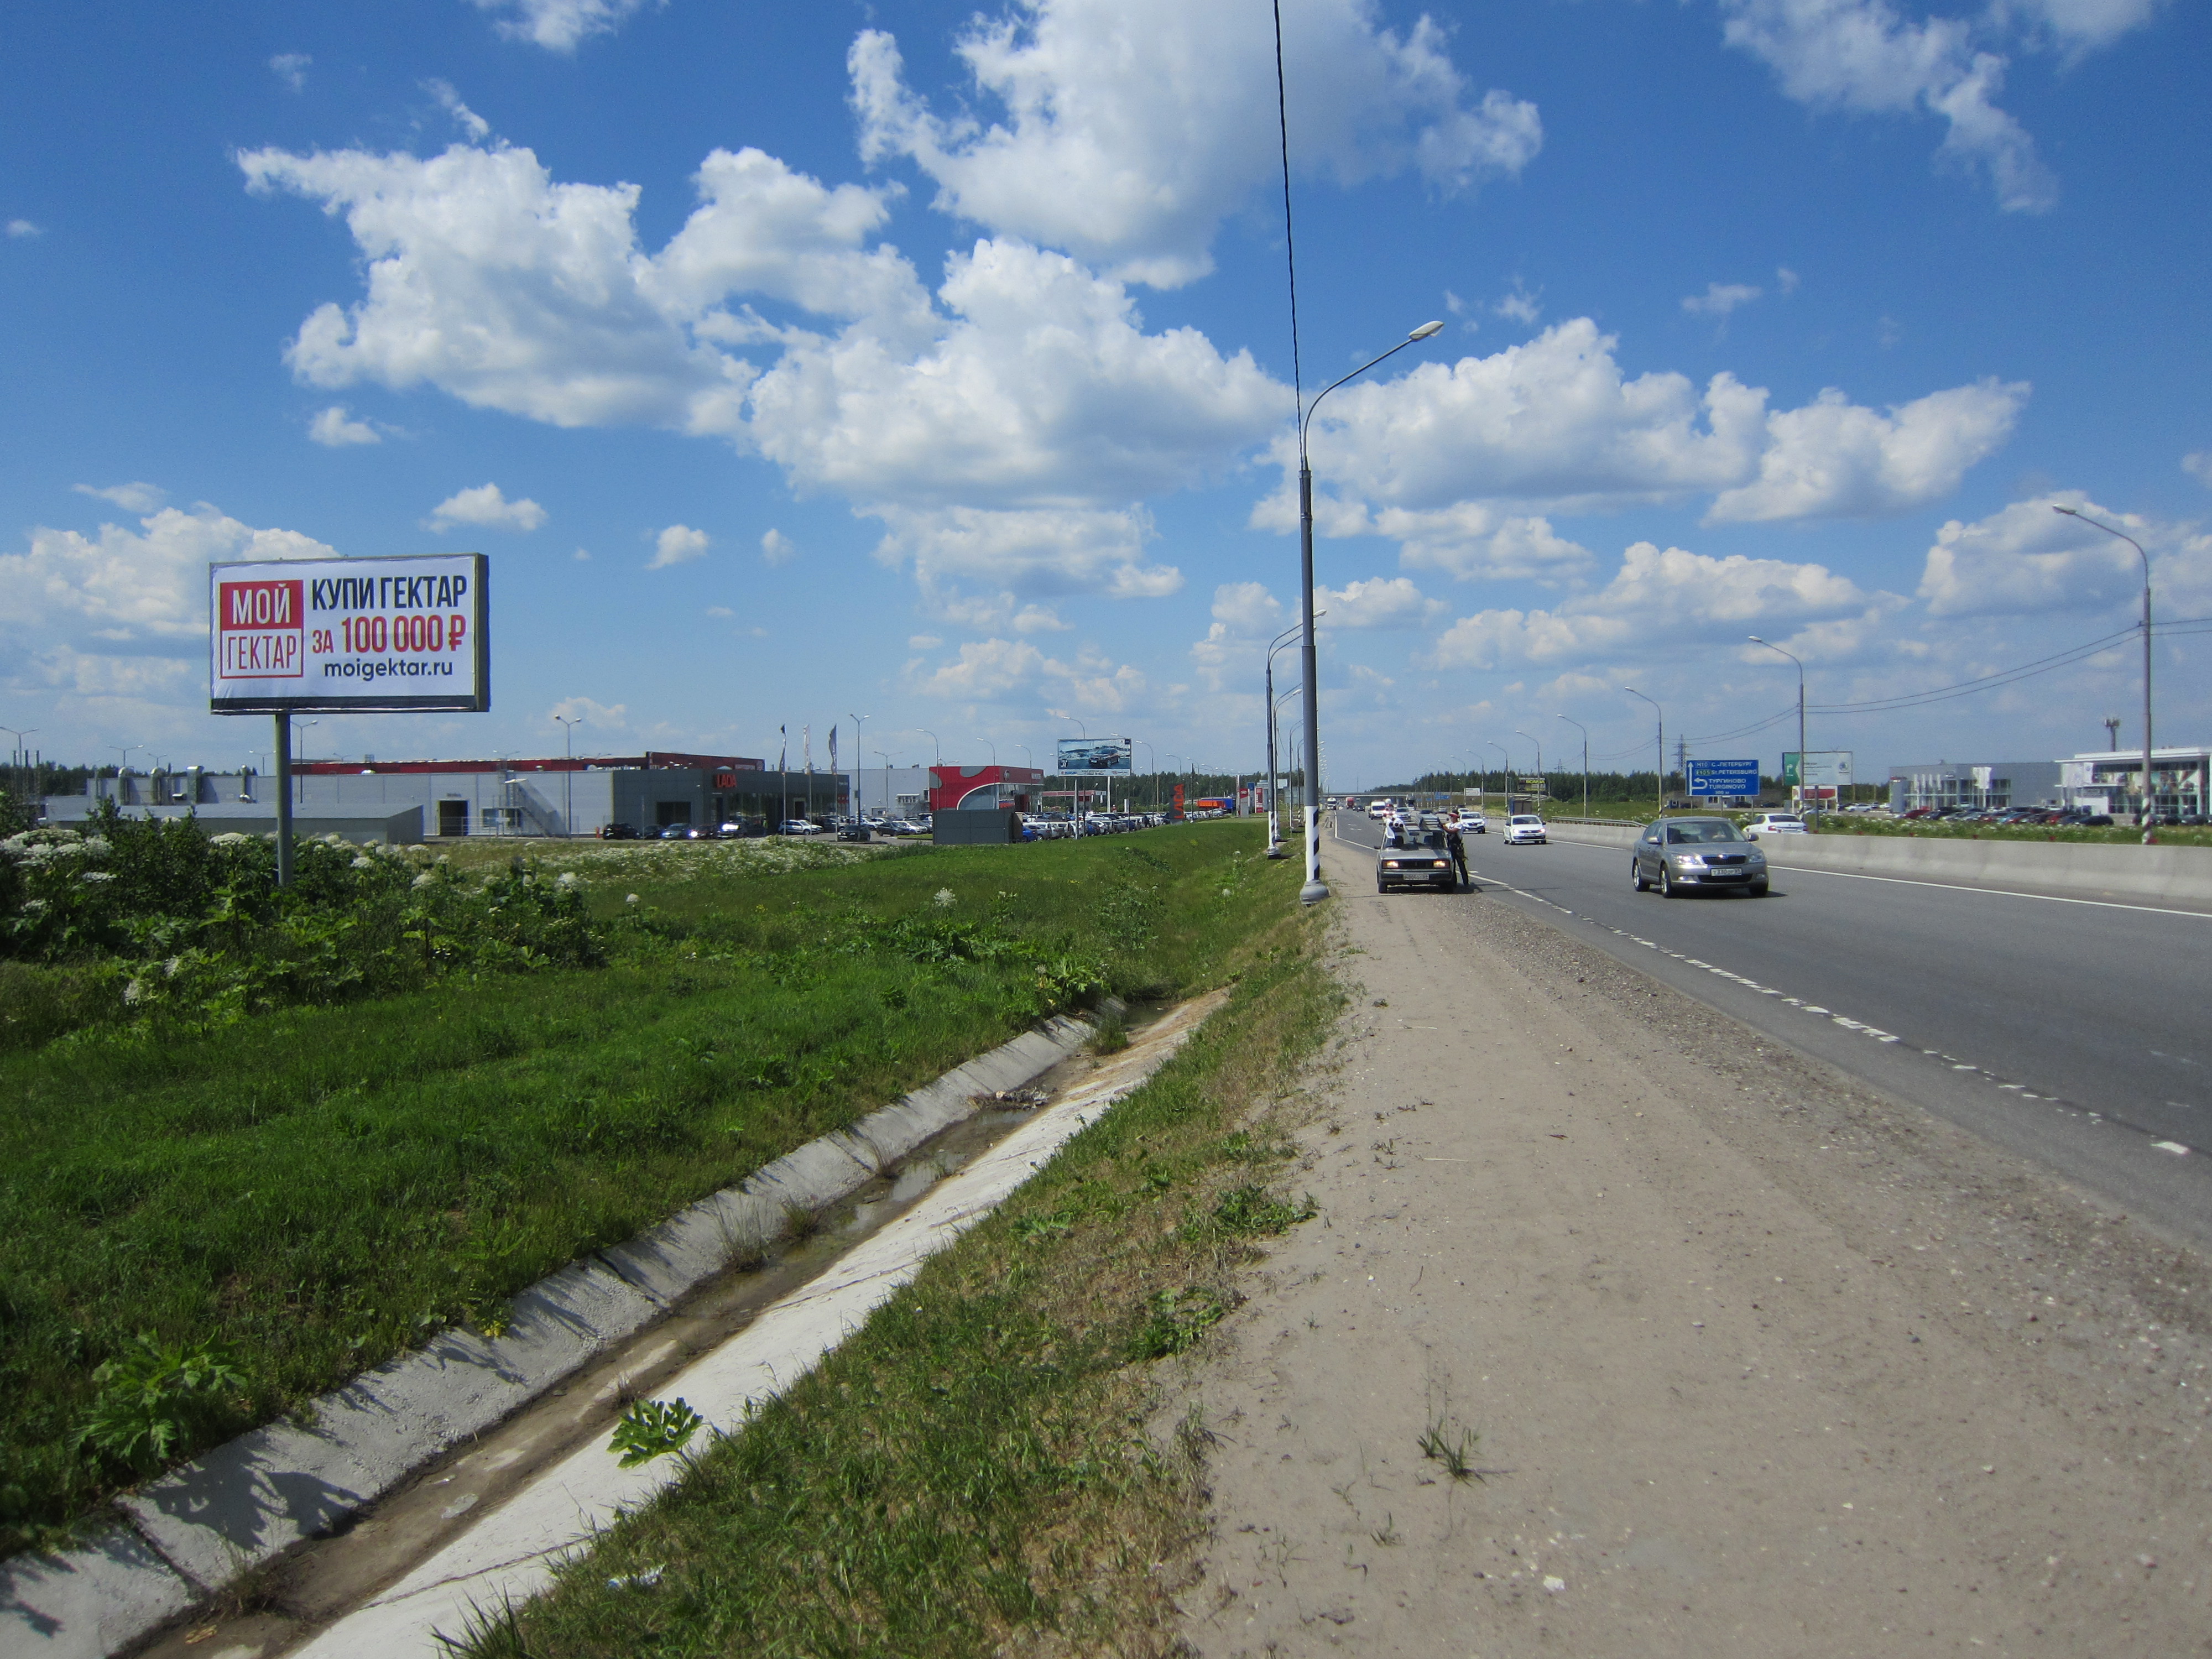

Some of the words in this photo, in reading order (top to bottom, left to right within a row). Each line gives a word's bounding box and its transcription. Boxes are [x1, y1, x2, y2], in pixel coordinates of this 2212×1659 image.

[232, 583, 291, 625] МОЙ
[311, 577, 374, 611] КУПИ
[380, 575, 467, 608] ГЕКТАР
[312, 629, 334, 654] ЗА
[341, 616, 387, 653] 100
[394, 615, 442, 653] 000
[227, 635, 296, 671] ГЕКТАР
[324, 658, 453, 681] moigektar.ru
[717, 774, 737, 788] LADA
[1174, 784, 1184, 818] LADA
